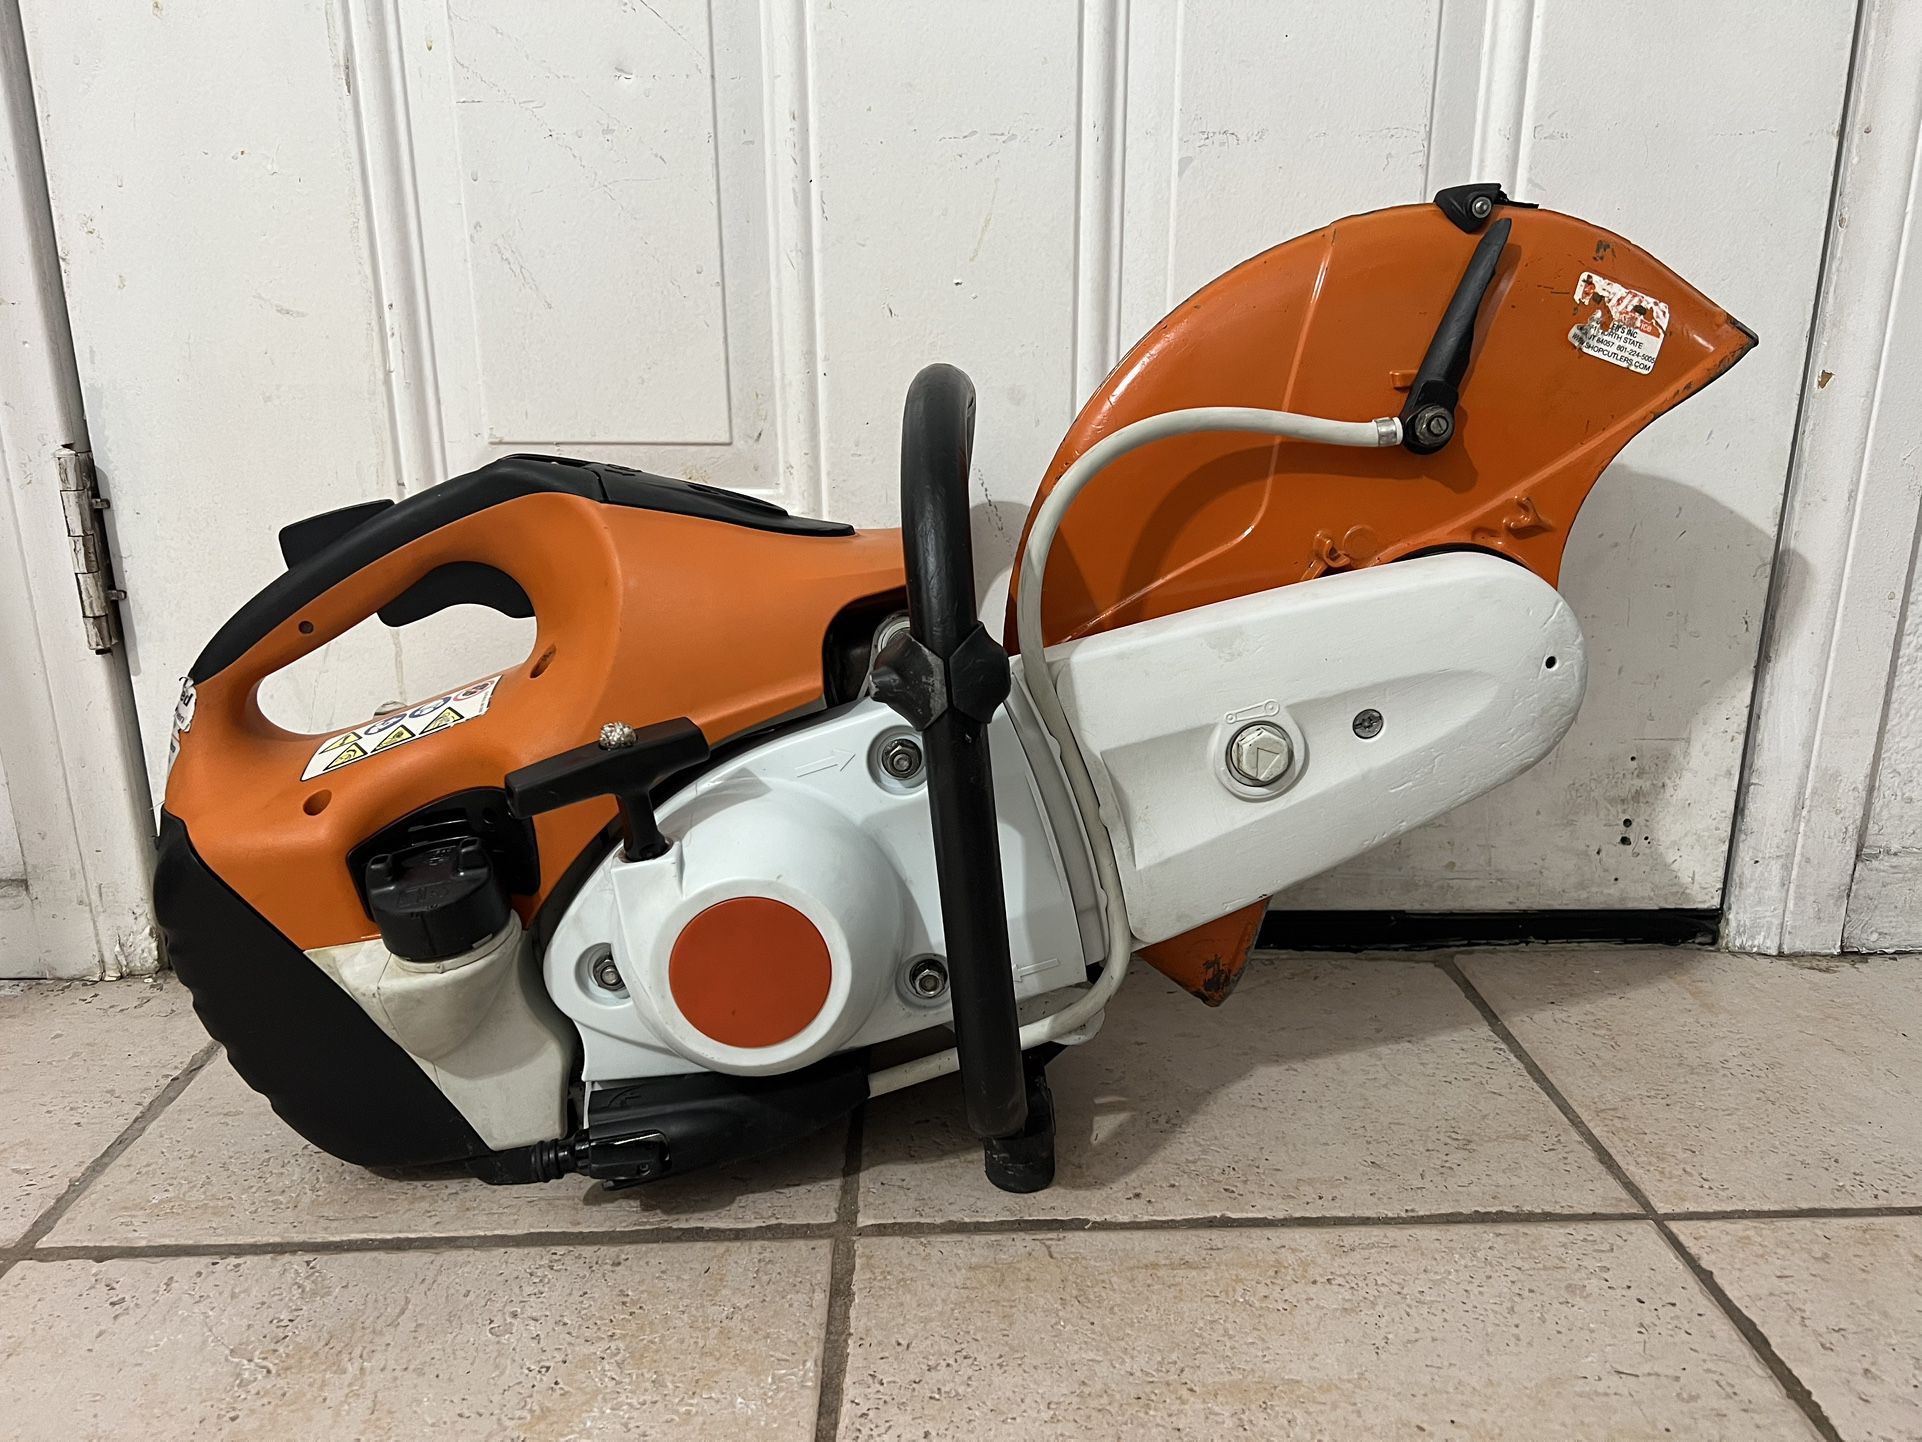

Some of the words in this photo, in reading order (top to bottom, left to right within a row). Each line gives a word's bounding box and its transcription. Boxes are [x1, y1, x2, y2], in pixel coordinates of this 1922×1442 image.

[1626, 329, 1638, 339] INC
[1596, 336, 1615, 348] 84057
[1615, 344, 1656, 364] 801-224-5005
[1624, 336, 1644, 350] STATE
